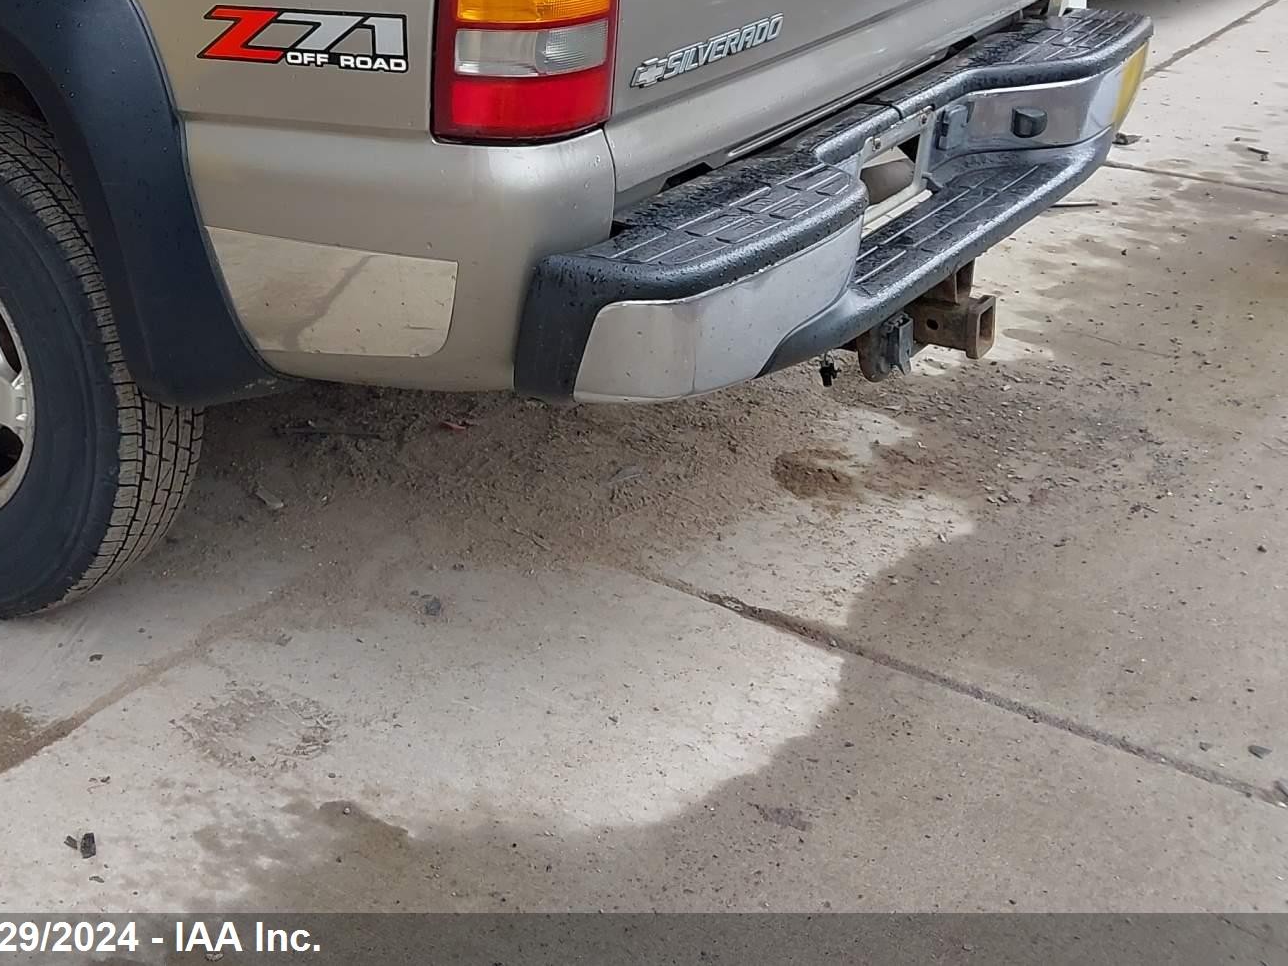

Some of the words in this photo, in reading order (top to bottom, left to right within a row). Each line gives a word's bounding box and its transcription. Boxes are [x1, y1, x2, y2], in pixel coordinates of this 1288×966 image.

[197, 4, 407, 63] Z71
[286, 51, 330, 66] OFF
[339, 57, 407, 72] ROAD
[663, 13, 785, 79] SILVERADO
